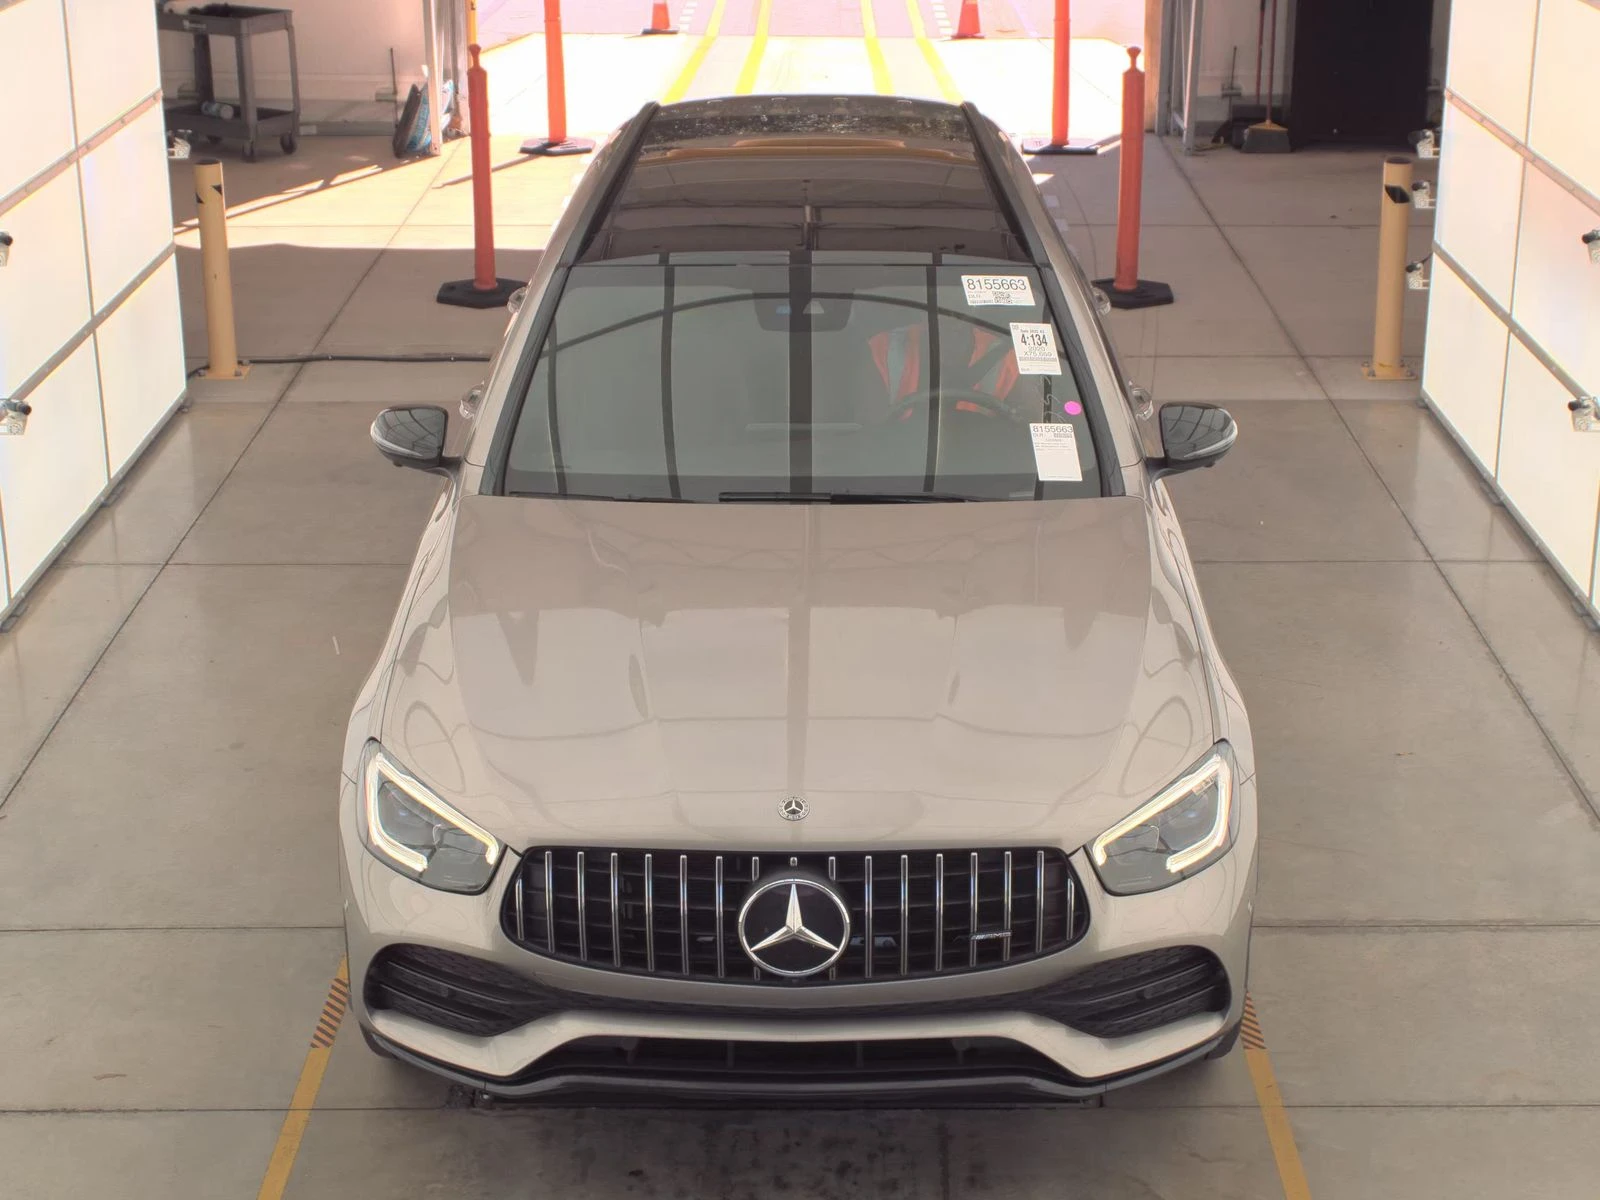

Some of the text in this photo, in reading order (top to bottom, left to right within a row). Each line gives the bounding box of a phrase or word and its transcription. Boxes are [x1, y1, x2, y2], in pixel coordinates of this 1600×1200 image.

[966, 278, 1027, 291] 8155663
[1020, 333, 1048, 346] 4:134
[1032, 425, 1074, 433] 8155663
